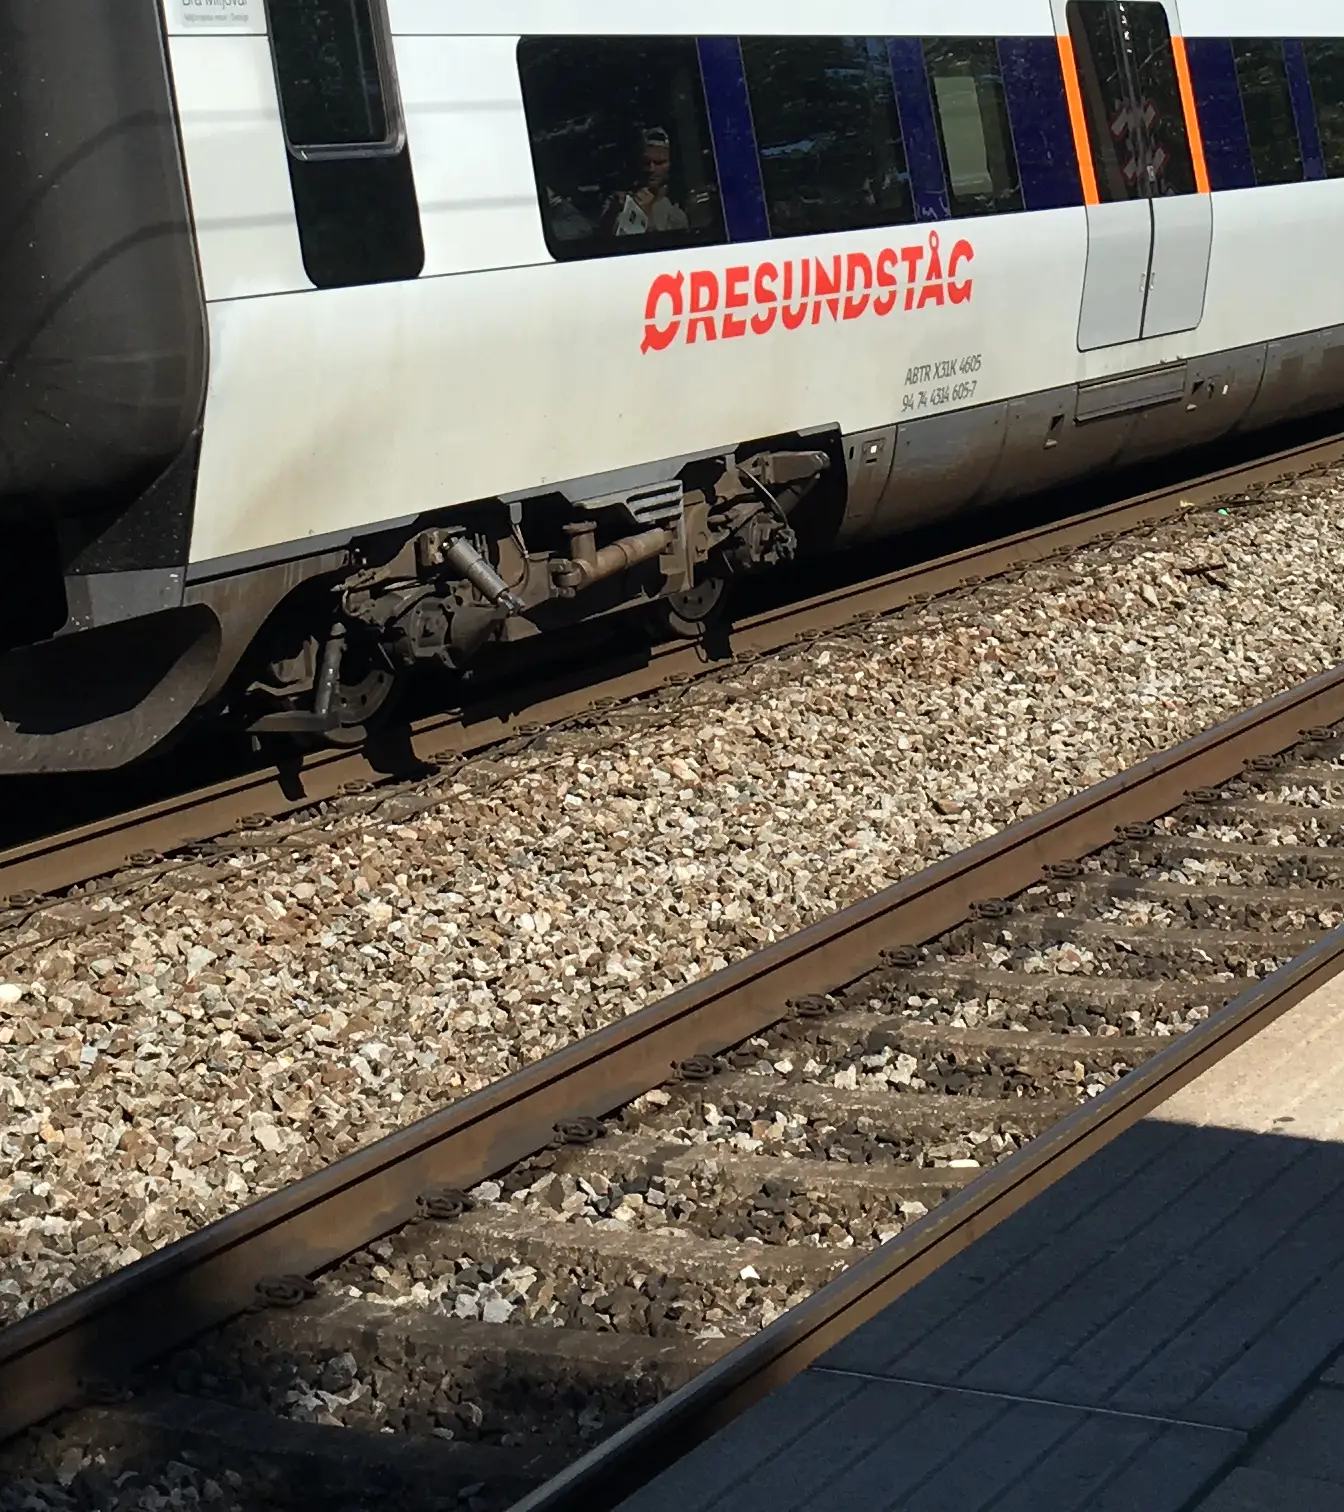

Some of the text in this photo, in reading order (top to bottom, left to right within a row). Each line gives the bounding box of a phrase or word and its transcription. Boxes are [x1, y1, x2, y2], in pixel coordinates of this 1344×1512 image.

[640, 230, 975, 355] ØRESUNDSTÅG
[904, 353, 982, 386] ABTR X31K 4605
[901, 392, 915, 412] 94
[916, 390, 928, 409] 74
